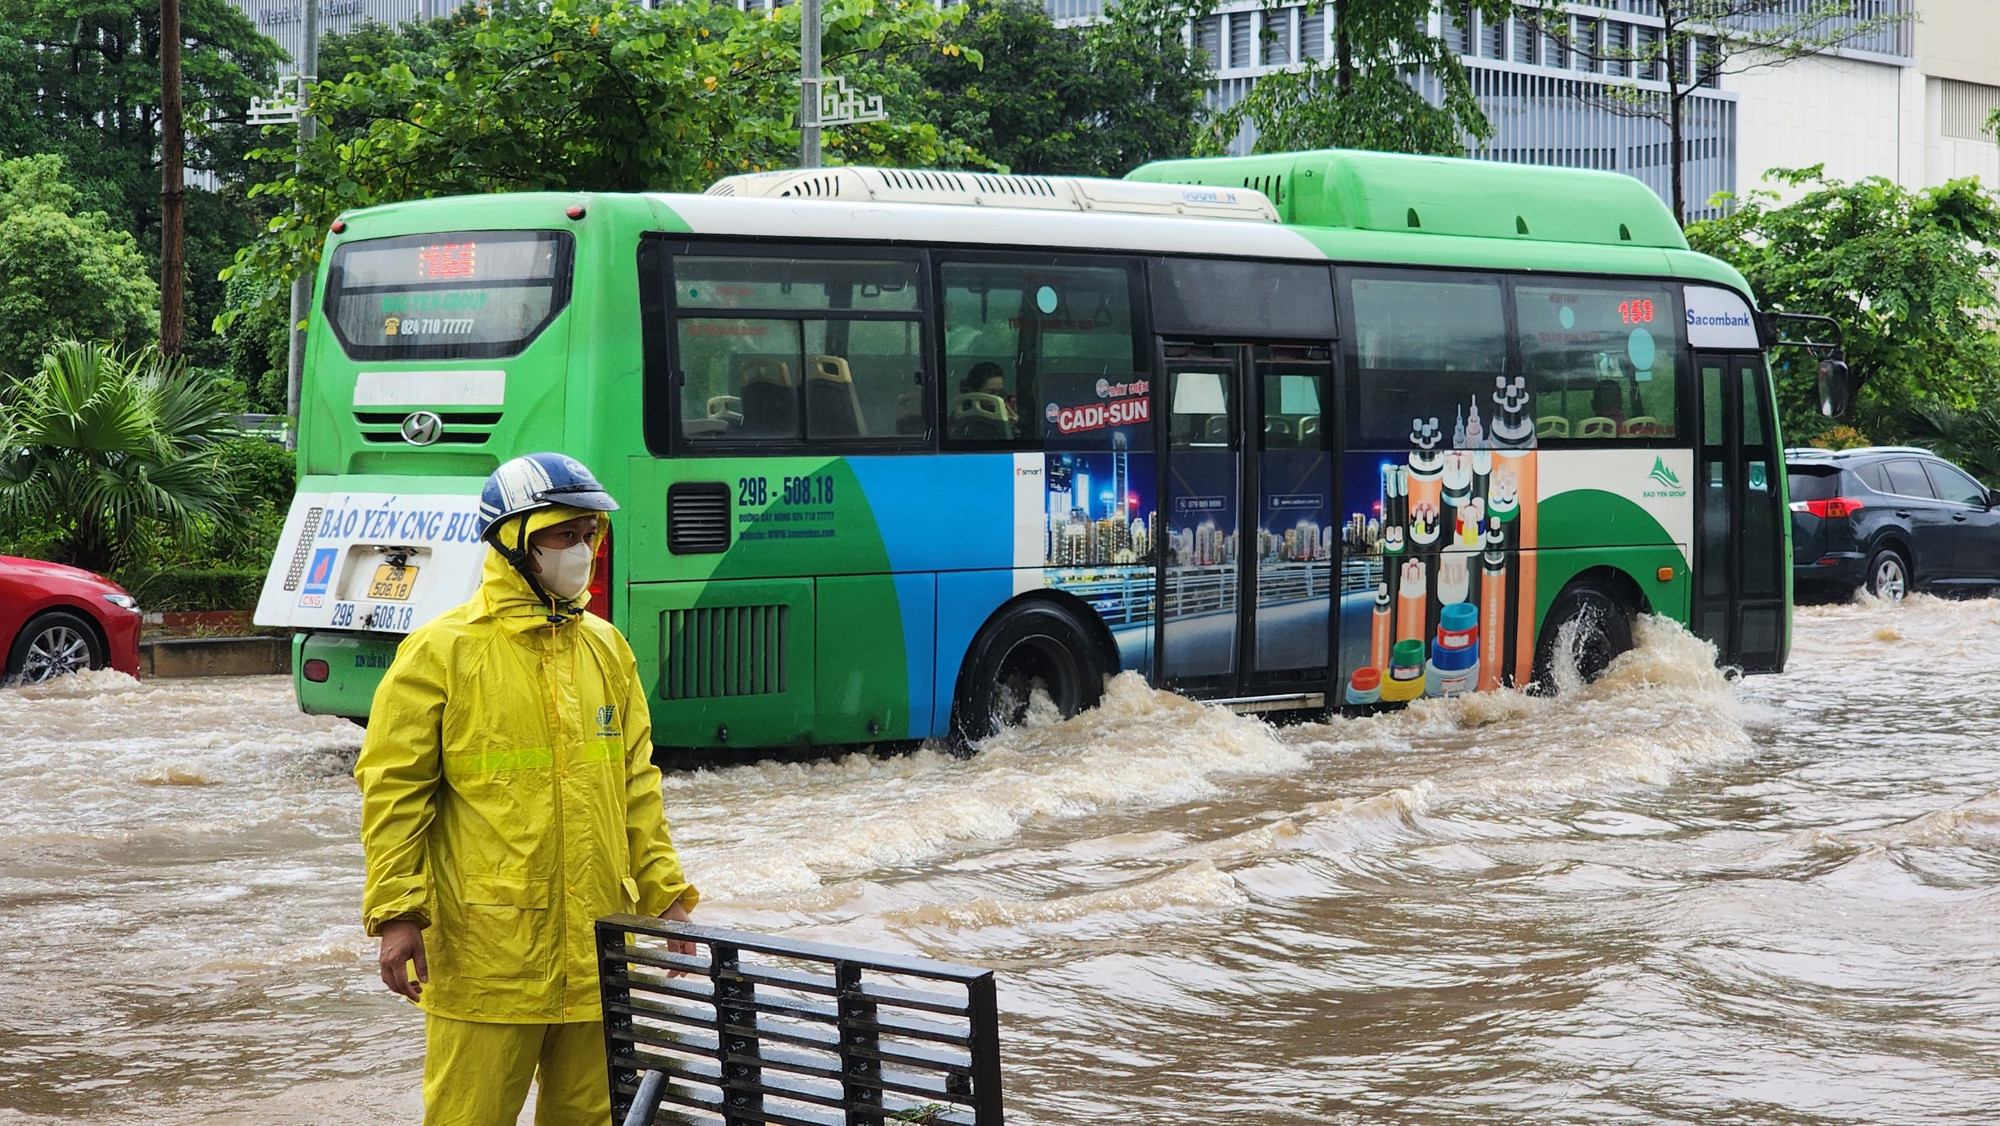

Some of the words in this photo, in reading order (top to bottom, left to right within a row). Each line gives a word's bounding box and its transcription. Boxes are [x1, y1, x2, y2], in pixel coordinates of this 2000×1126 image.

[401, 320, 419, 335] 024
[422, 319, 440, 334] 710
[442, 319, 474, 334] 77777
[1687, 309, 1750, 326] Sacombank
[1059, 400, 1148, 431] CADI-SUN
[739, 477, 767, 506] 29B
[783, 476, 834, 505] 508.18
[318, 496, 359, 538] BẢO
[359, 496, 402, 539] YẾN
[400, 511, 444, 541] CNG
[386, 567, 405, 581] 29B
[303, 596, 321, 605] CNG
[372, 583, 407, 598] 508.18
[331, 604, 354, 627] 29B
[371, 605, 413, 630] 508.18
[1488, 598, 1497, 662] CADI-SUN
